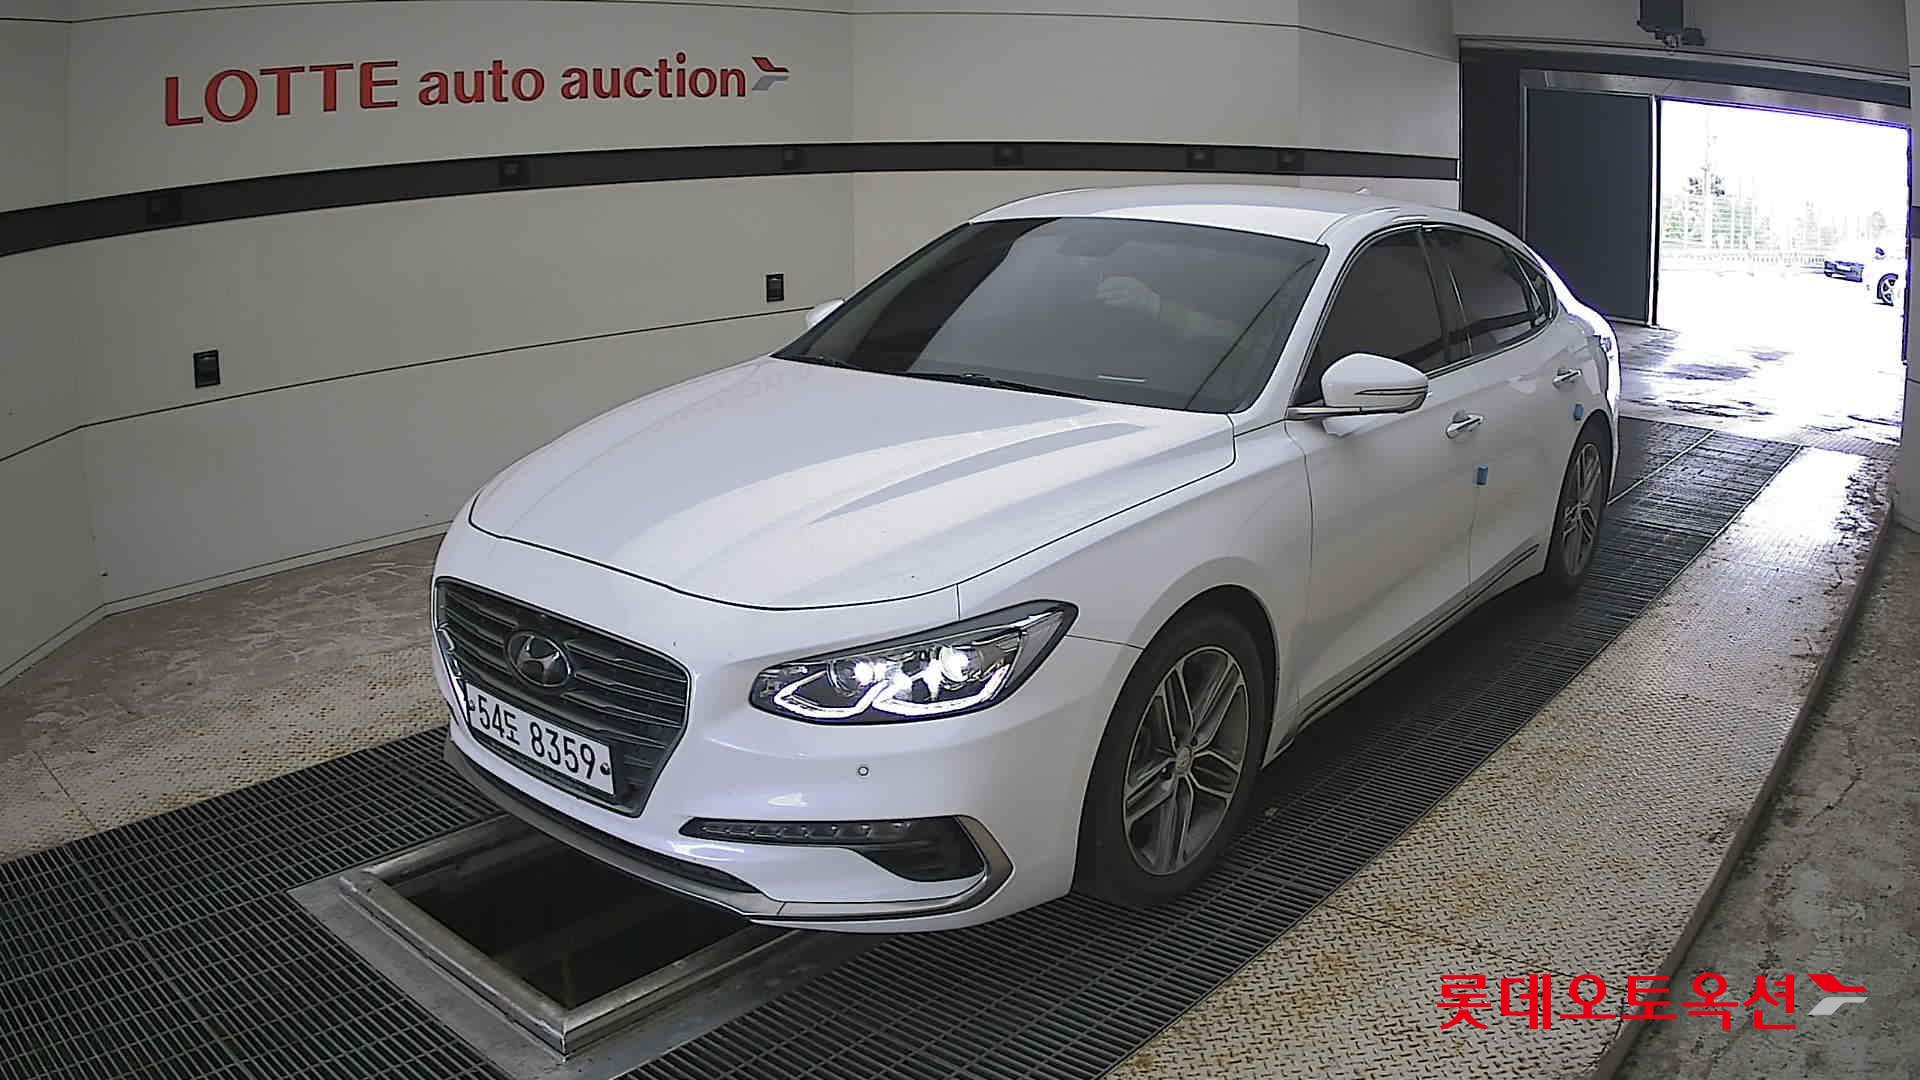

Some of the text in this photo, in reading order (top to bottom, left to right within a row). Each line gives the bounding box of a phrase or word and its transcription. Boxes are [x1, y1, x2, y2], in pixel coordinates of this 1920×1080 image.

[164, 52, 747, 126] LOTTE auto auction
[478, 694, 596, 780] 54도 8359
